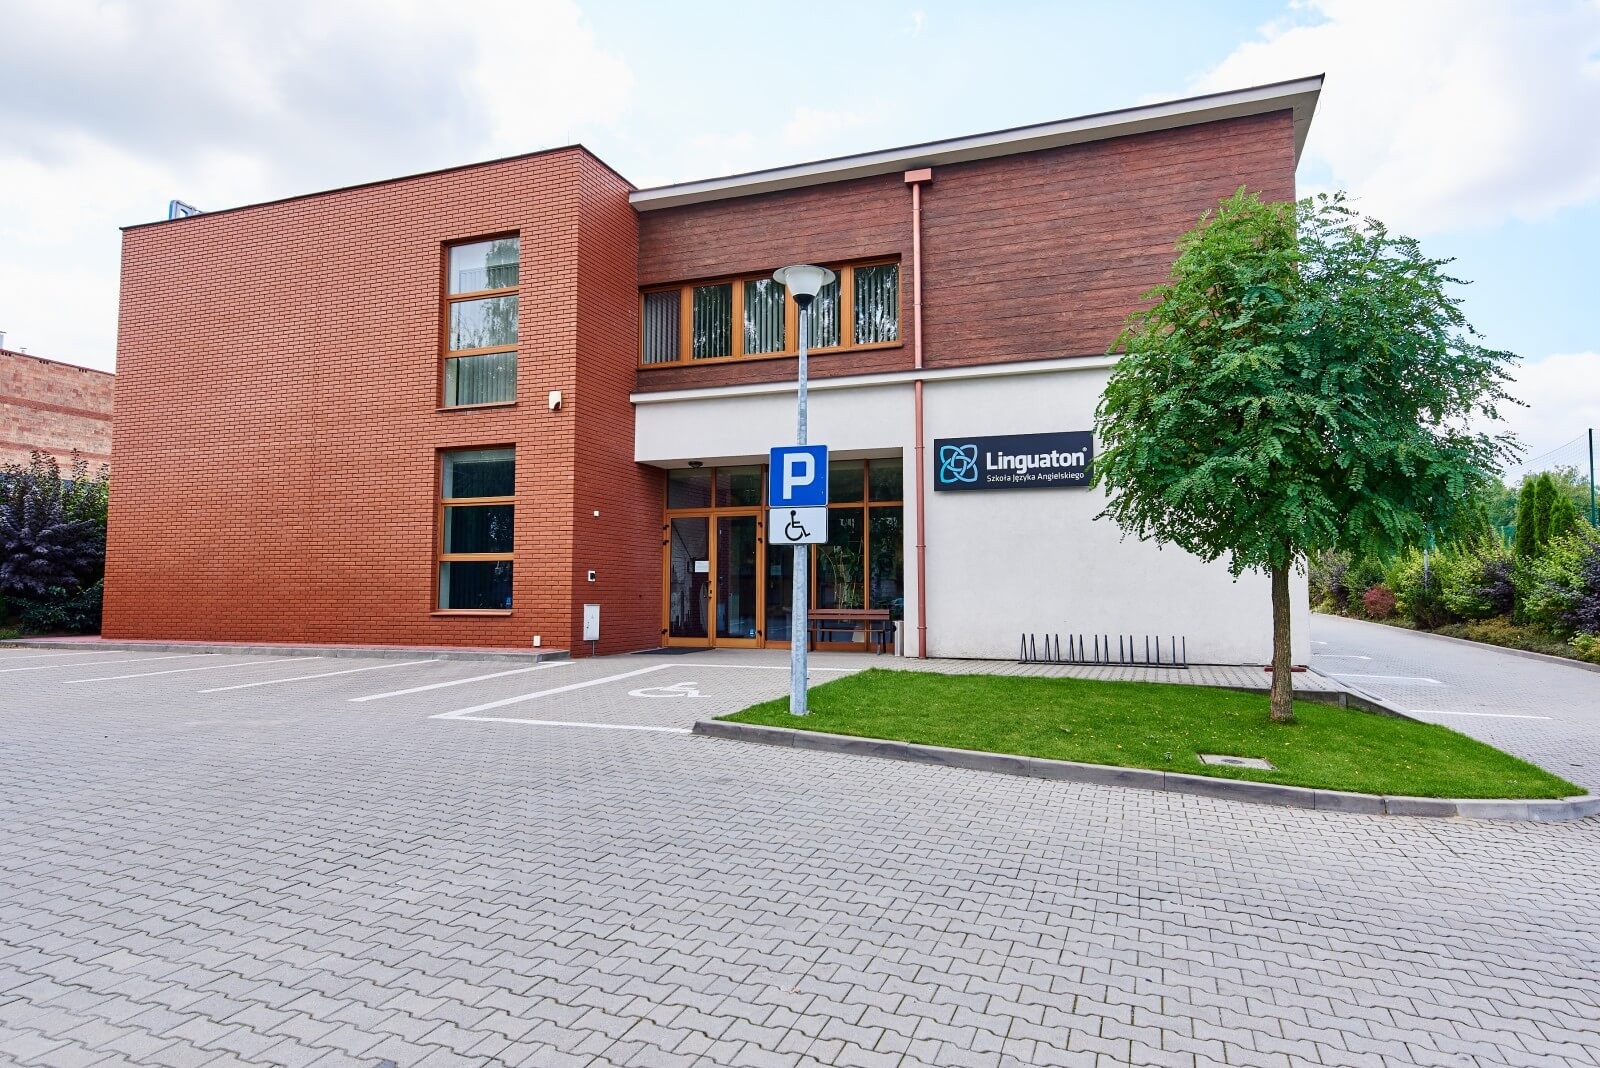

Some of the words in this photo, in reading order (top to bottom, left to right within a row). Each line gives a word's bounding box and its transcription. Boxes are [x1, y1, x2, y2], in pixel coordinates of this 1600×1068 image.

[783, 453, 815, 500] P
[987, 474, 1011, 482] Szkoła
[1012, 473, 1036, 482] Języka
[1037, 472, 1085, 482] Angielskiego
